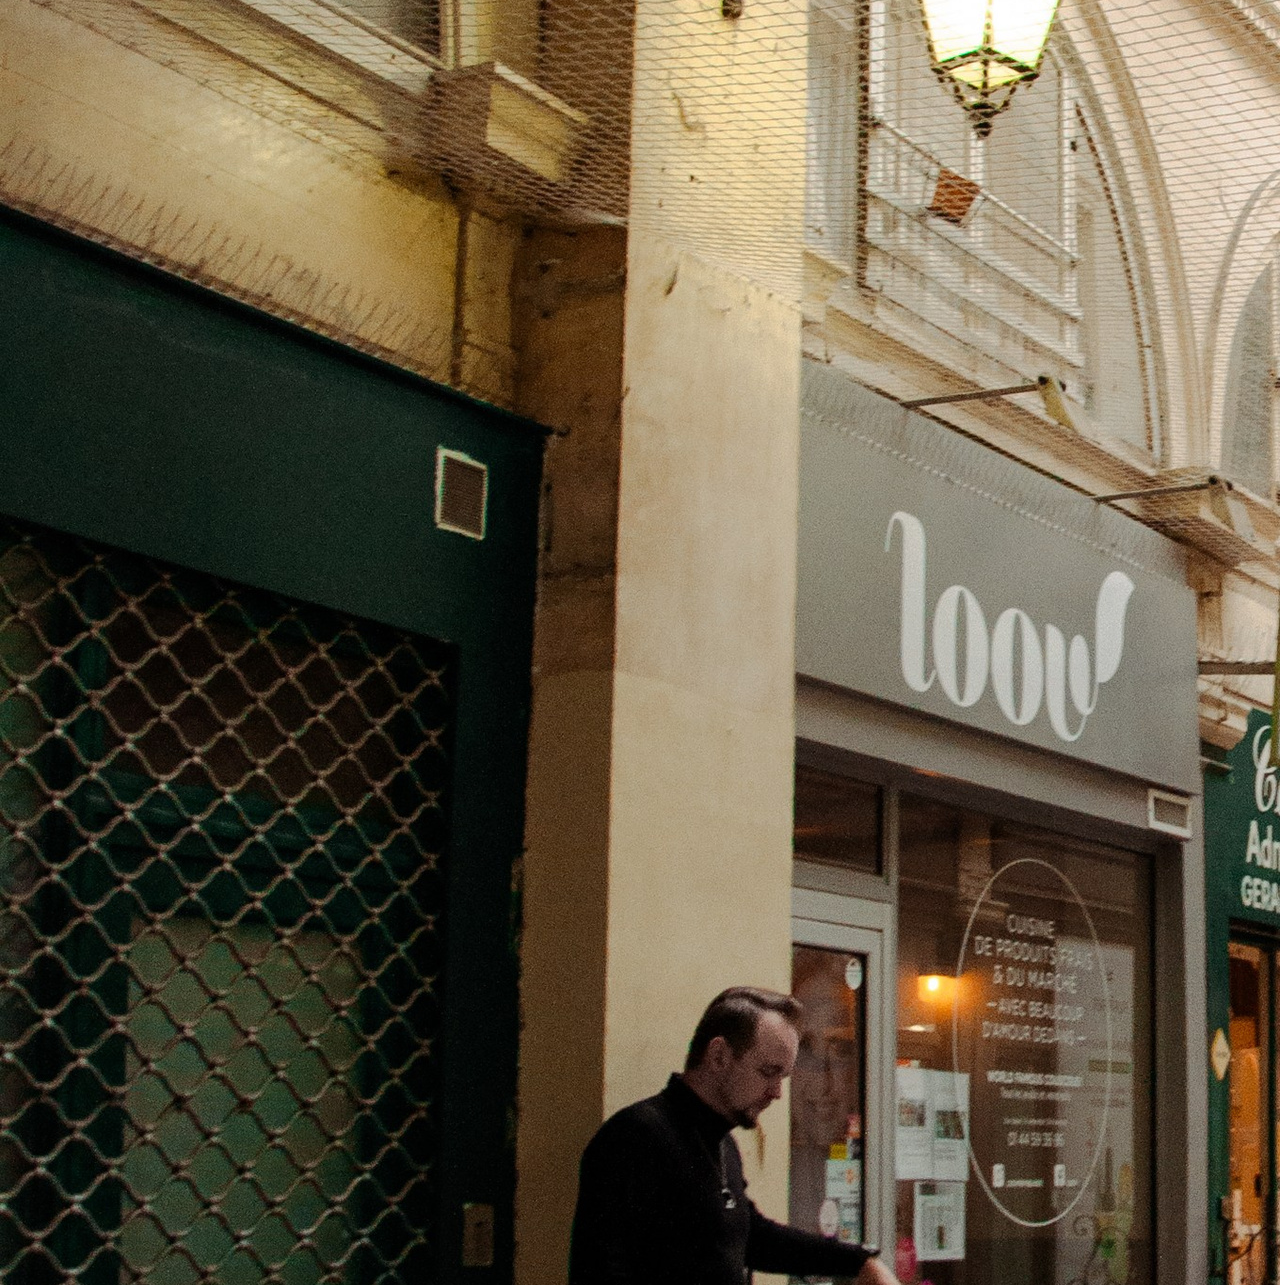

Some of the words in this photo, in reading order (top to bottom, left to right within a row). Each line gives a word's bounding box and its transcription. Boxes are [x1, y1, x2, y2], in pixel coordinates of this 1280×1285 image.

[974, 935, 993, 956] DE
[996, 938, 1057, 965] PRODUITS
[1006, 966, 1026, 987] DU
